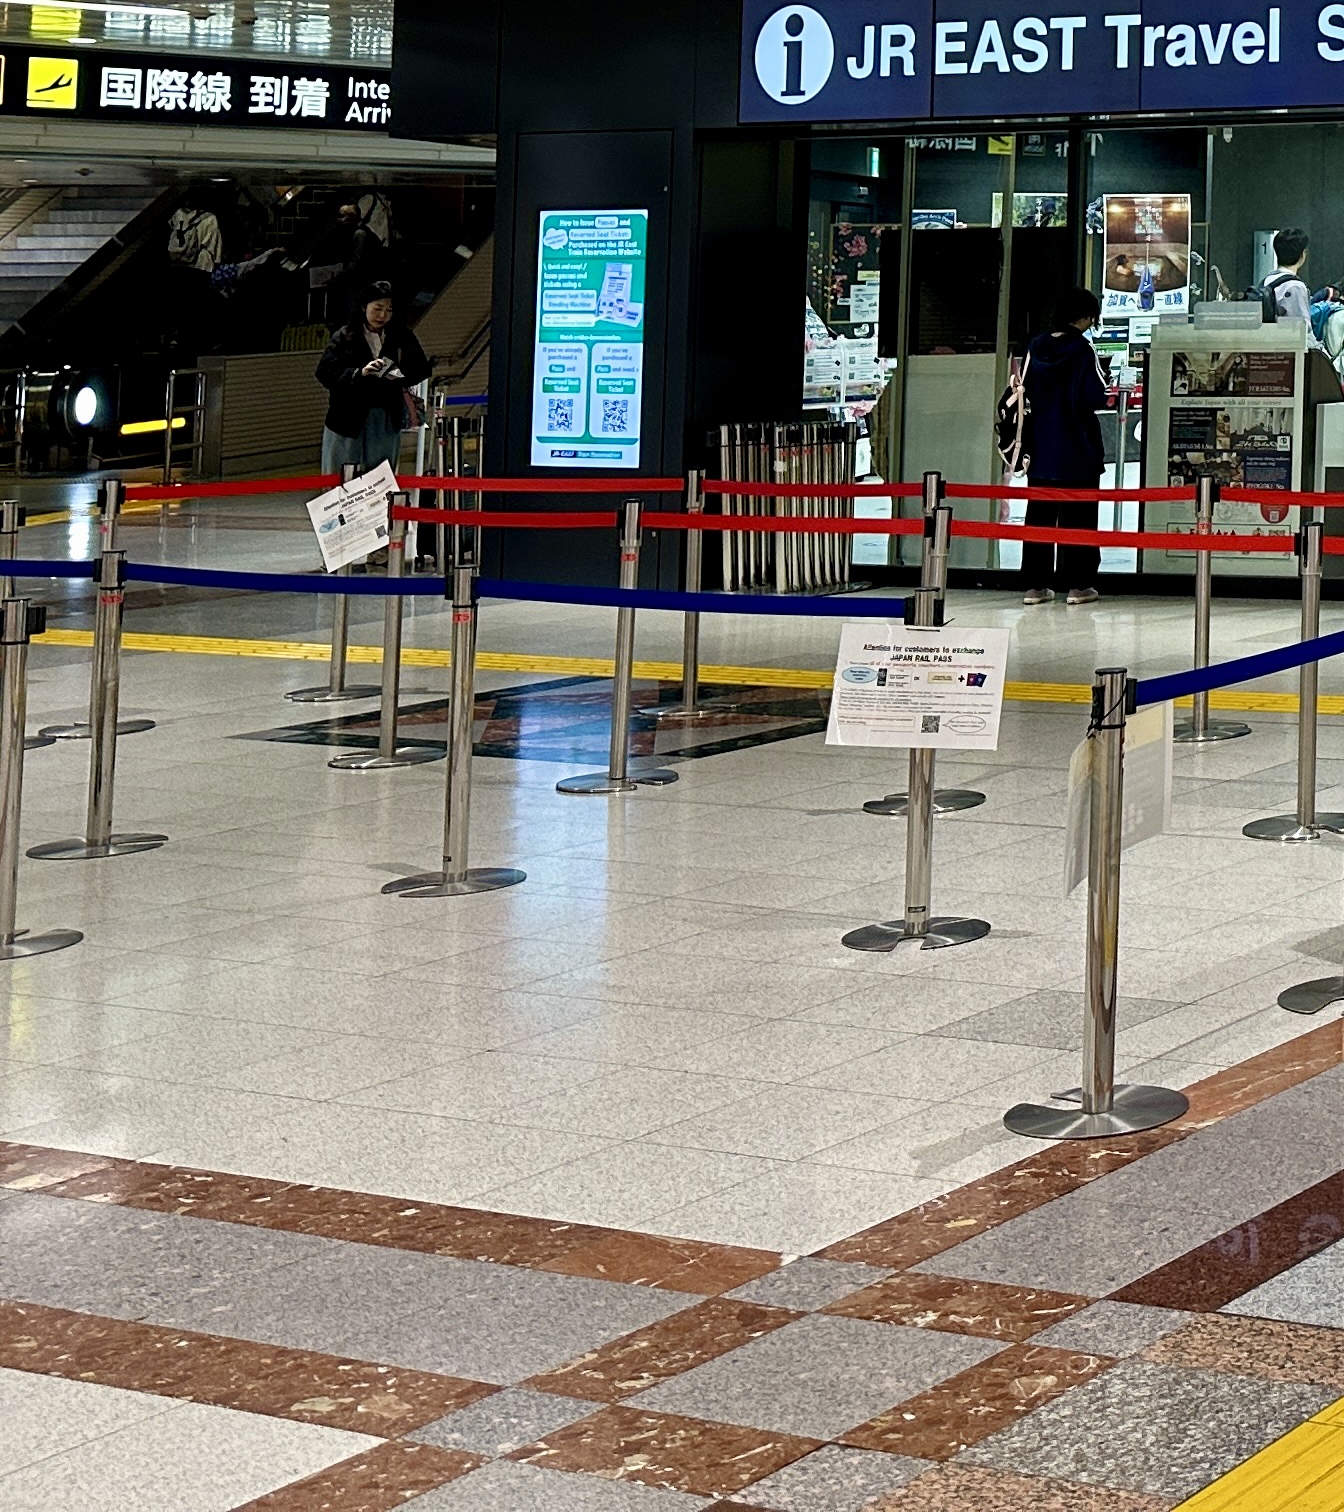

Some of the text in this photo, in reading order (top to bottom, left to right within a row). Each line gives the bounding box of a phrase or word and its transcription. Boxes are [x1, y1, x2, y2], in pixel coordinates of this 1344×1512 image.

[847, 24, 915, 79] JR
[936, 17, 1086, 74] EAST
[1105, 8, 1279, 68] Travel
[99, 67, 329, 117] 国際線 到着
